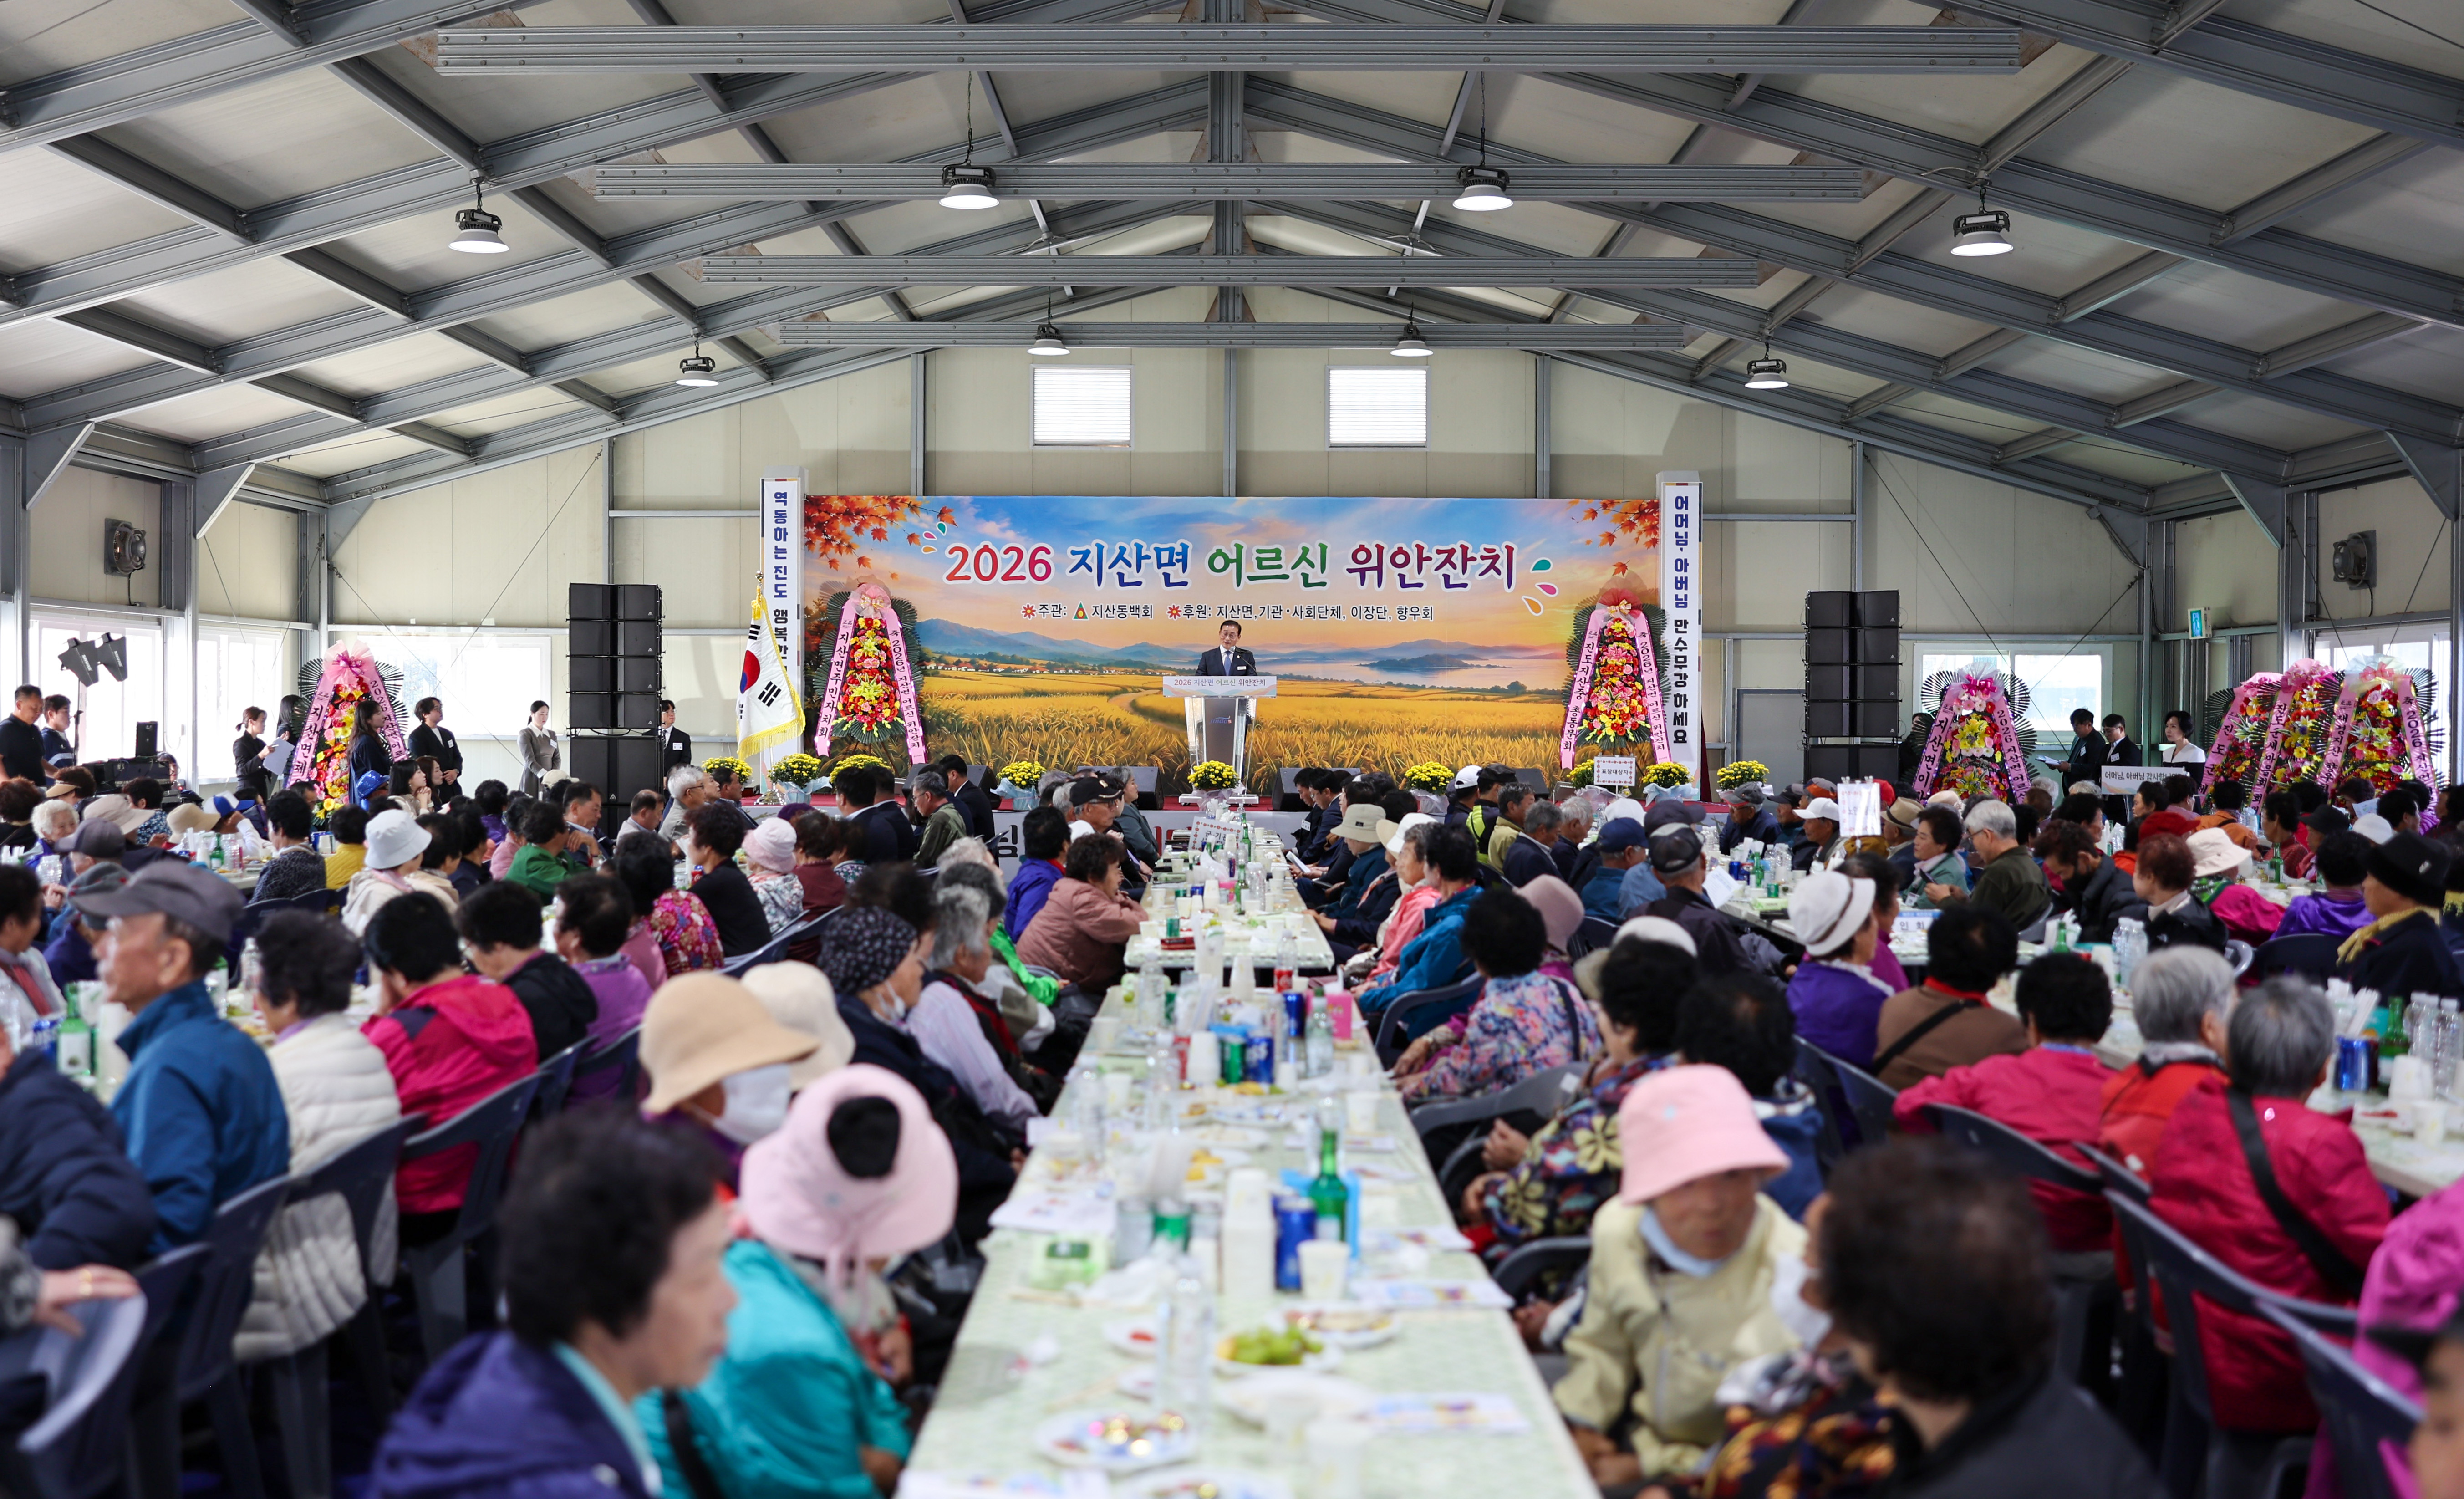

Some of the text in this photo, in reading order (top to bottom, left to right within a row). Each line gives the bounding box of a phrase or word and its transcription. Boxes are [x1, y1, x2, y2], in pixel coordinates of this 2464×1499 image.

[774, 492, 788, 560] 역동하는
[946, 543, 1514, 590] 2026 지산면 어르신 위안잔치
[774, 566, 787, 598] 진도
[1675, 558, 1689, 608] 아버님
[1039, 604, 1067, 618] 주관:
[1092, 604, 1153, 619] 지산동백회
[1183, 604, 1211, 618] 후원:
[1351, 605, 1390, 621] 이장단,
[1396, 605, 1433, 620] 향우회
[82, 654, 92, 671] SHURE
[114, 650, 123, 667] SHURE
[892, 640, 906, 673] 2026년
[1639, 642, 1654, 674] 2026년
[819, 631, 850, 739] 지산면주민자치회
[898, 676, 910, 695] 지산면
[1238, 678, 1266, 687] 위안잔치
[1646, 678, 1658, 698] 지산면
[902, 698, 915, 718] 어르신
[1563, 642, 1594, 751] 진도지산중 총동문회
[1649, 700, 1661, 721] 어르신
[907, 721, 920, 748] 위안잔치
[1653, 724, 1665, 750] 위안잔치
[1997, 710, 2013, 743] 2026
[2006, 746, 2022, 771] 지산면
[2406, 710, 2423, 748] 2026
[294, 704, 323, 782] 지산면체
[392, 741, 406, 760] 어르
[2105, 771, 2125, 780] 어머님,
[2127, 772, 2144, 780] 아버님
